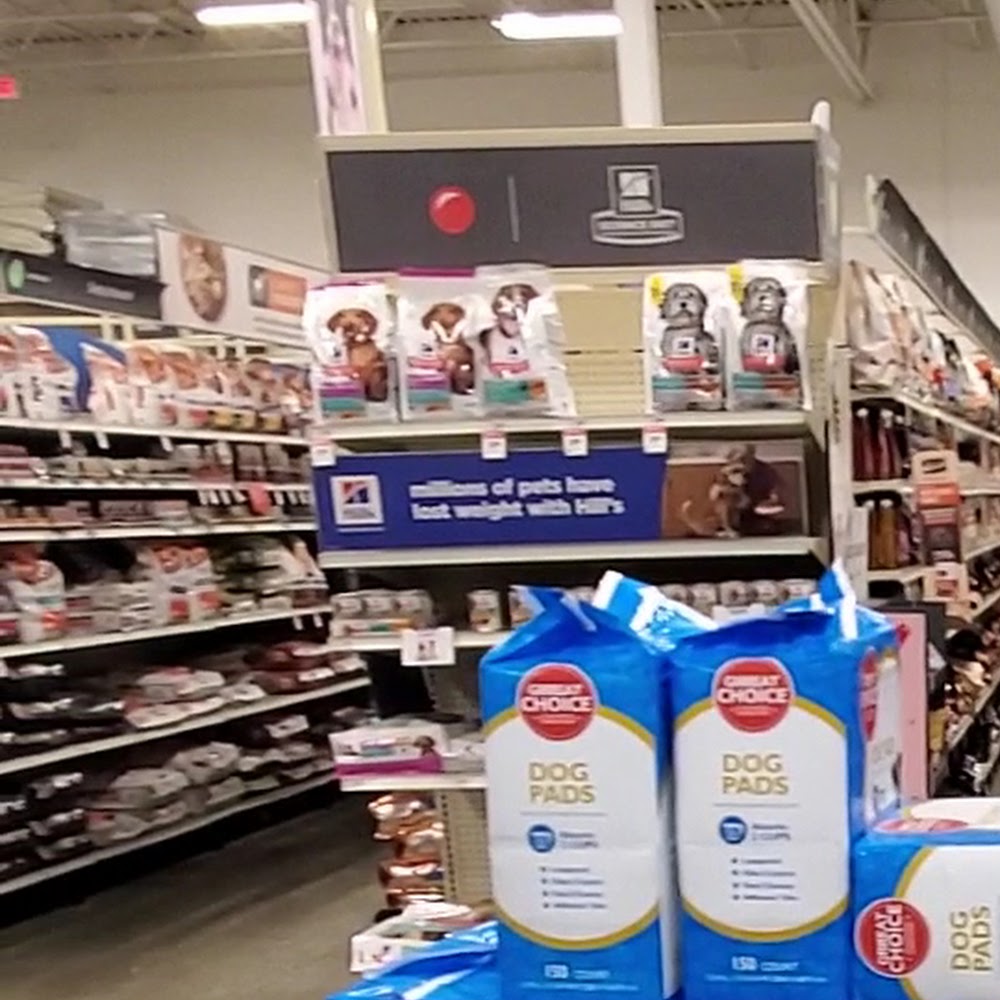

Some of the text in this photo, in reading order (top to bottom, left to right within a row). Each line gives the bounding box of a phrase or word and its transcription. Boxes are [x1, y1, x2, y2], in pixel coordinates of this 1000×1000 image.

[409, 476, 616, 498] millions of pets have
[411, 498, 625, 521] lost weight with Hill's
[527, 683, 583, 695] GREAT
[722, 675, 783, 687] GREAT
[521, 696, 593, 712] CHOICE
[717, 688, 790, 704] CHOICE
[529, 762, 588, 781] DOG
[722, 754, 782, 773] DOG
[529, 785, 595, 803] PADS
[722, 776, 789, 795] PADS
[874, 911, 890, 967] GREAT
[884, 904, 906, 974] CHOICE
[951, 911, 970, 970] DOG
[971, 905, 992, 972] PADS
[544, 964, 569, 979] 150
[732, 956, 758, 971] 150
